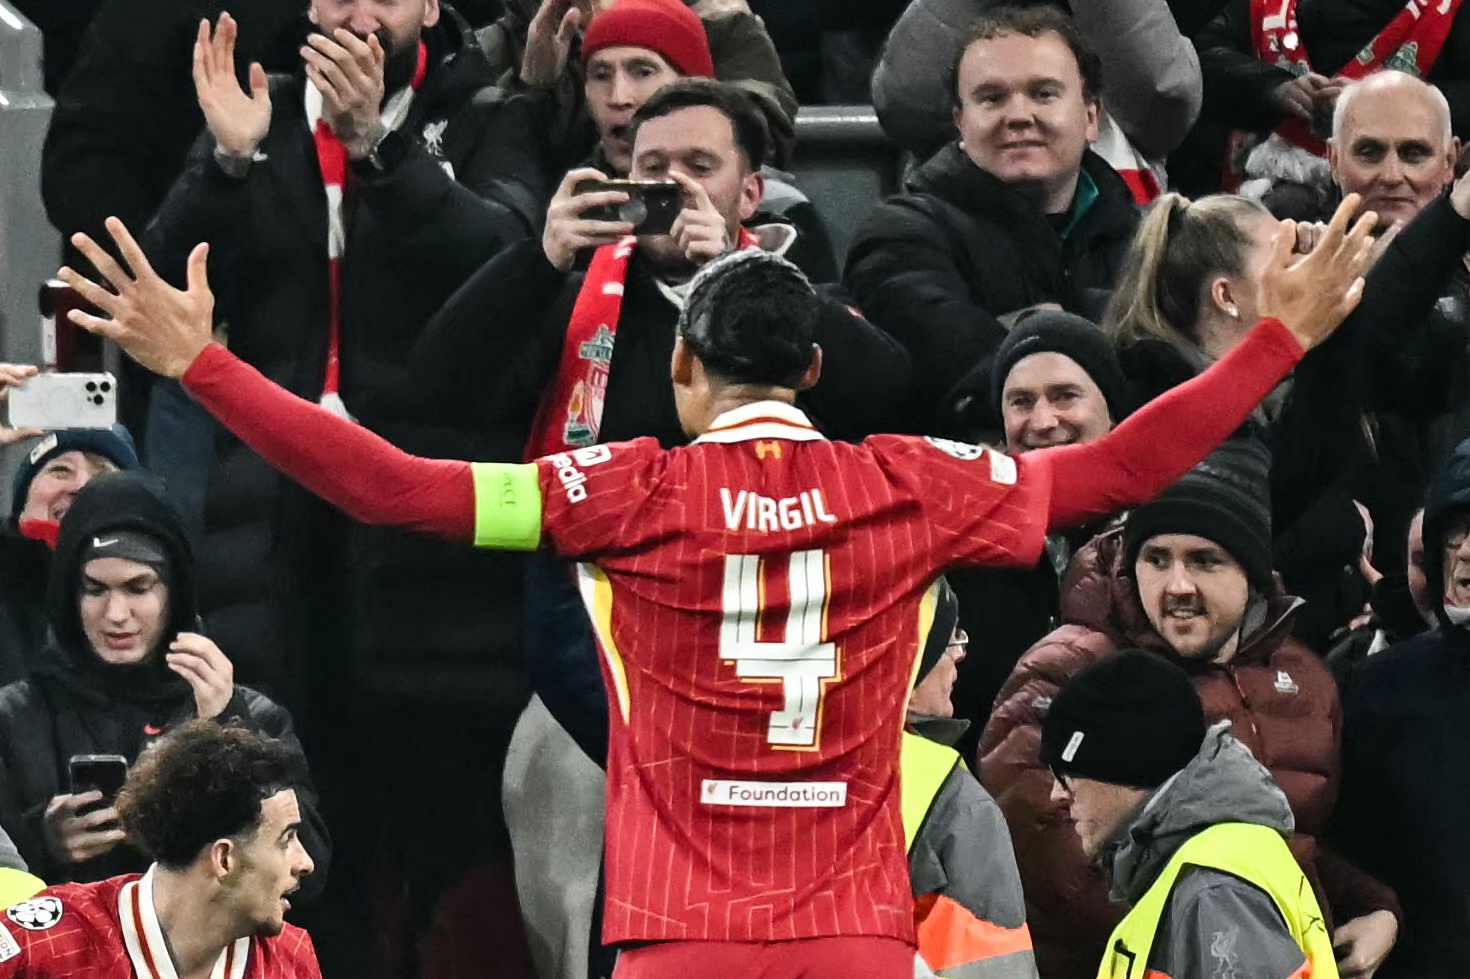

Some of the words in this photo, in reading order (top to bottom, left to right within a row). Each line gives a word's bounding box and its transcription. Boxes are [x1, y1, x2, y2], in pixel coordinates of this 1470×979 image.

[719, 487, 838, 535] VIRGIL
[719, 549, 842, 752] 4
[728, 785, 841, 802] Foundation
